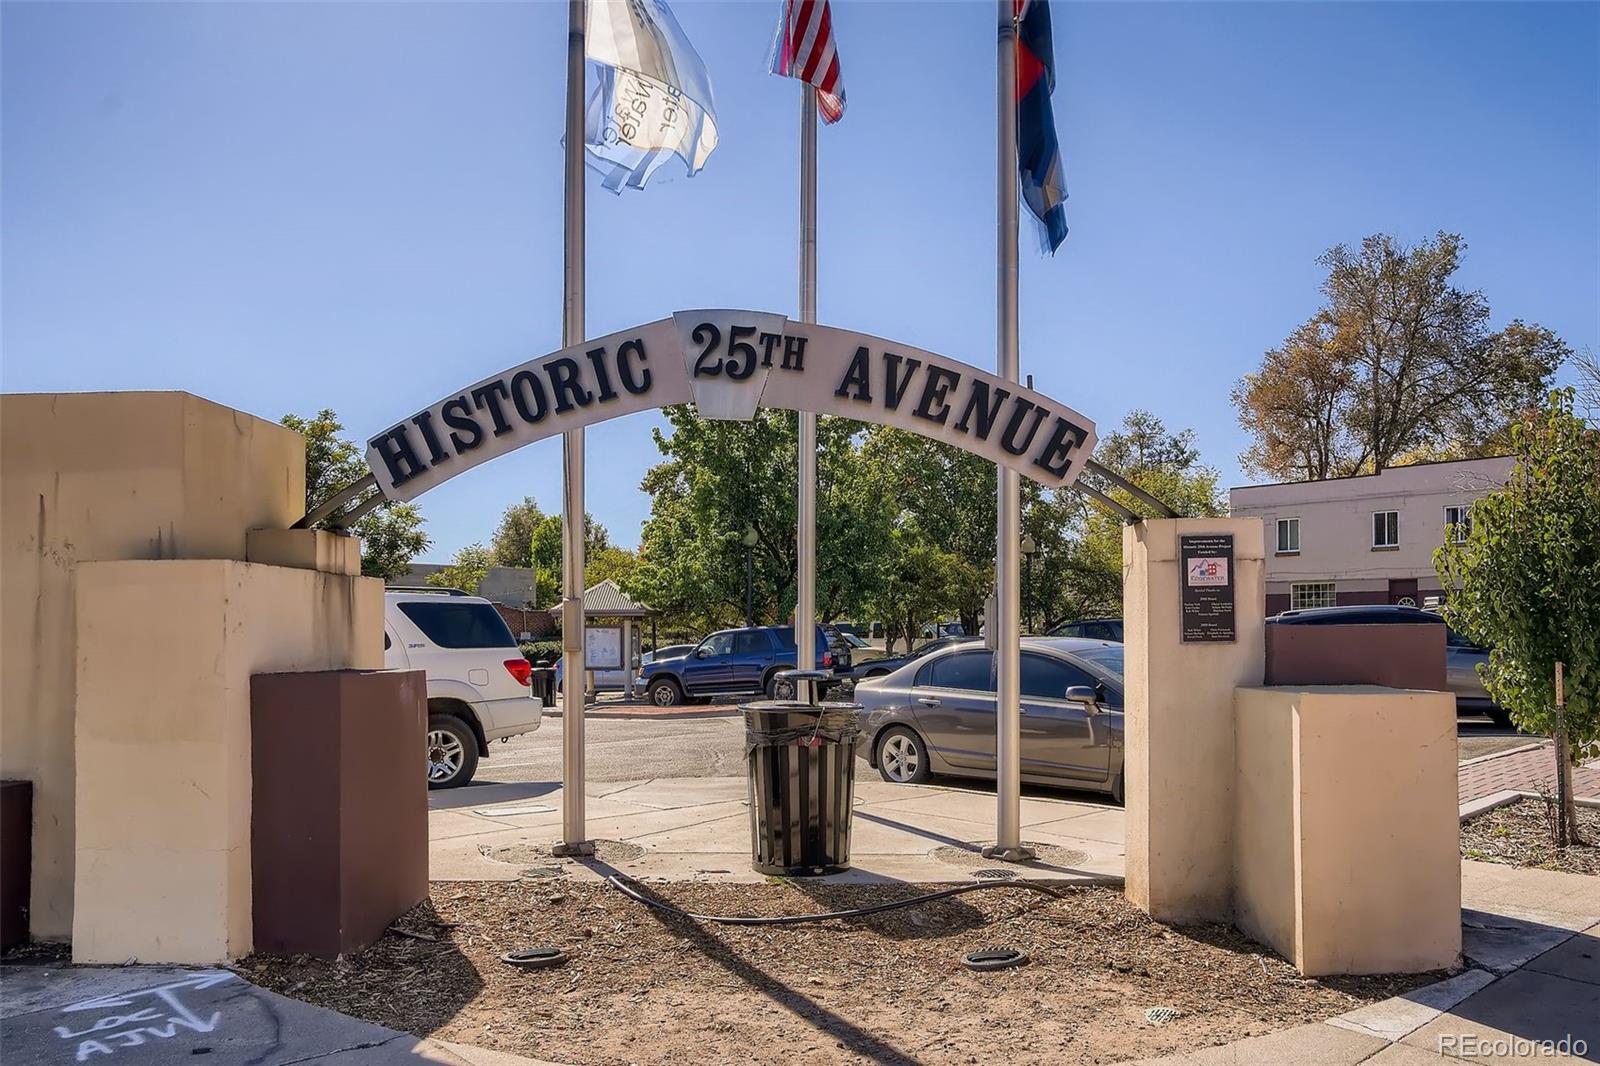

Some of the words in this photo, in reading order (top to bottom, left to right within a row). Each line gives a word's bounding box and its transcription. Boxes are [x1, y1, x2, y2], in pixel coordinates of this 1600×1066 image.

[370, 338, 651, 489] HISTORIC
[691, 322, 809, 380] 25TH
[834, 346, 1089, 479] AVENUE
